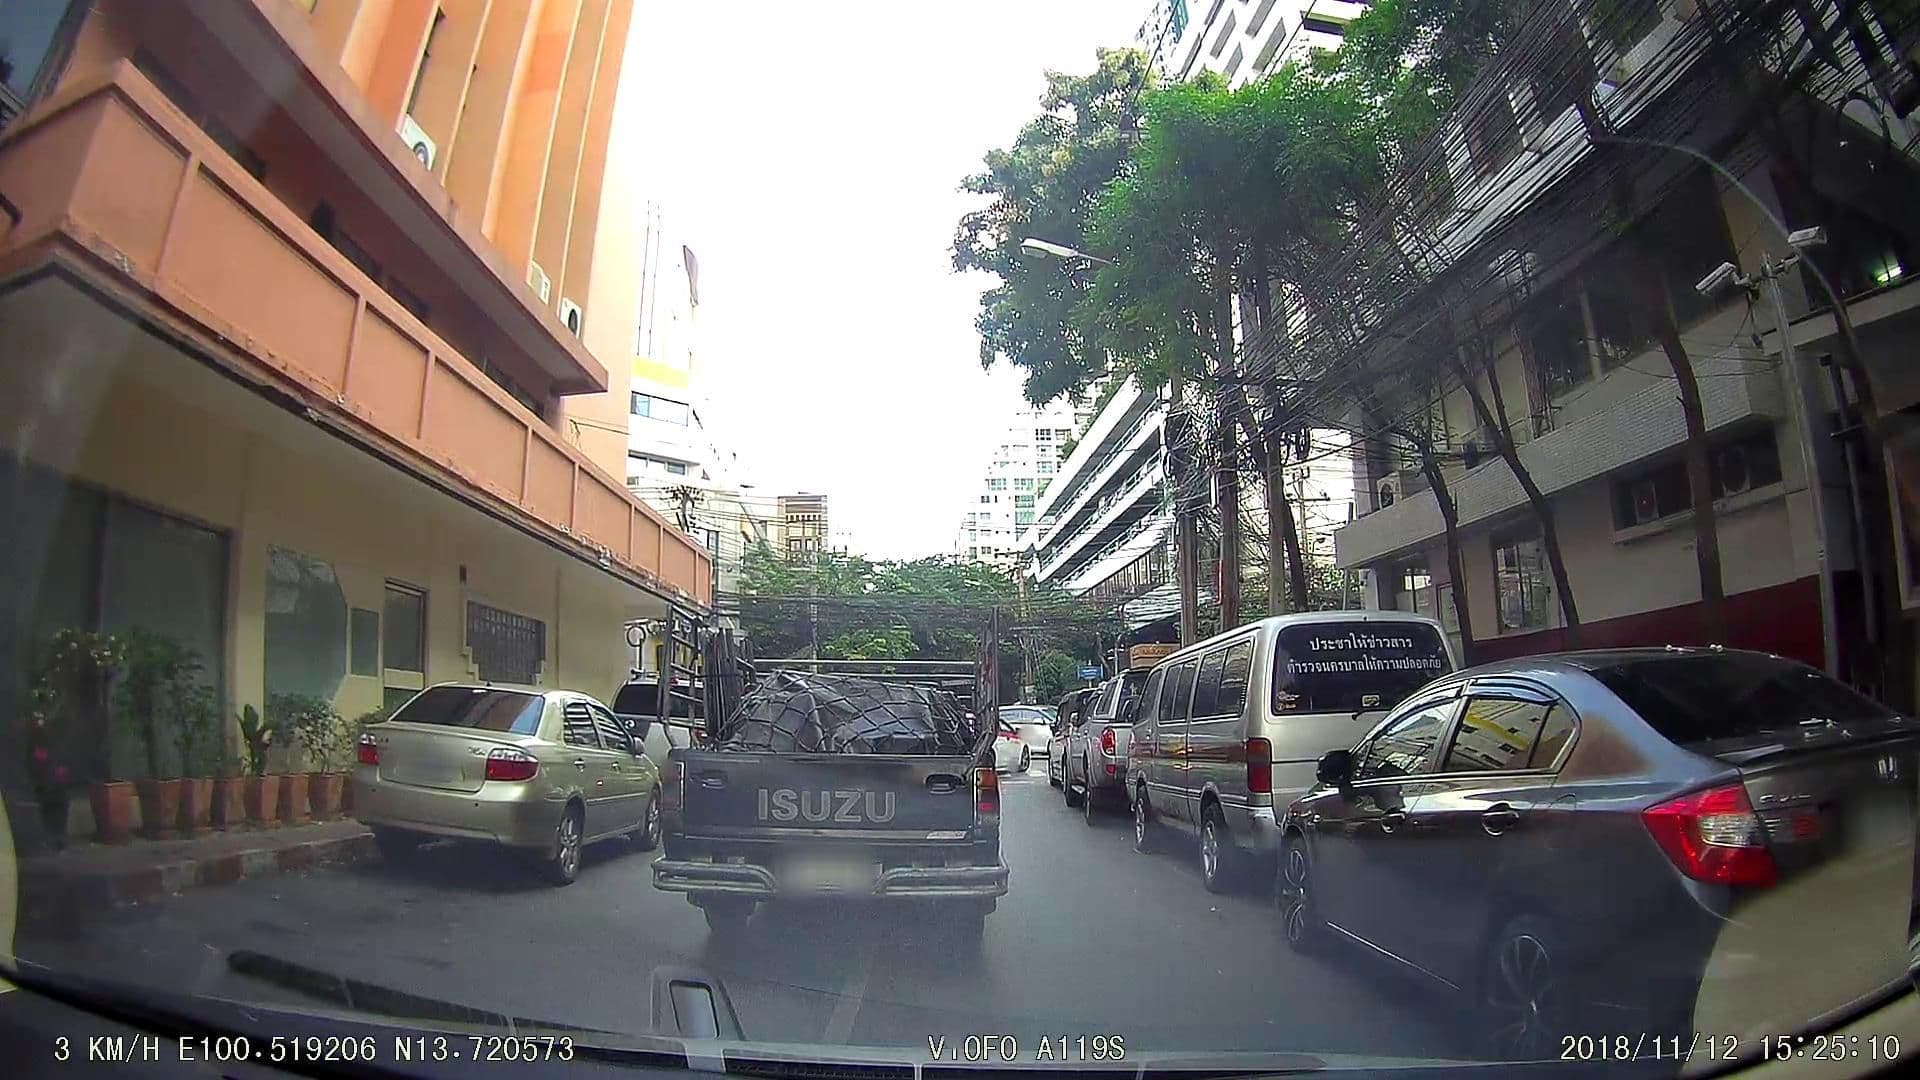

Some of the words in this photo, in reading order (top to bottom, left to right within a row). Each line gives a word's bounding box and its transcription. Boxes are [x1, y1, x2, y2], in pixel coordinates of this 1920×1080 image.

[1309, 632, 1413, 651] ประชาให้ข่าวสาร
[1287, 654, 1442, 674] ตำรวจนครบาลให้ความปลอดภัย
[758, 789, 896, 822] ISUZU
